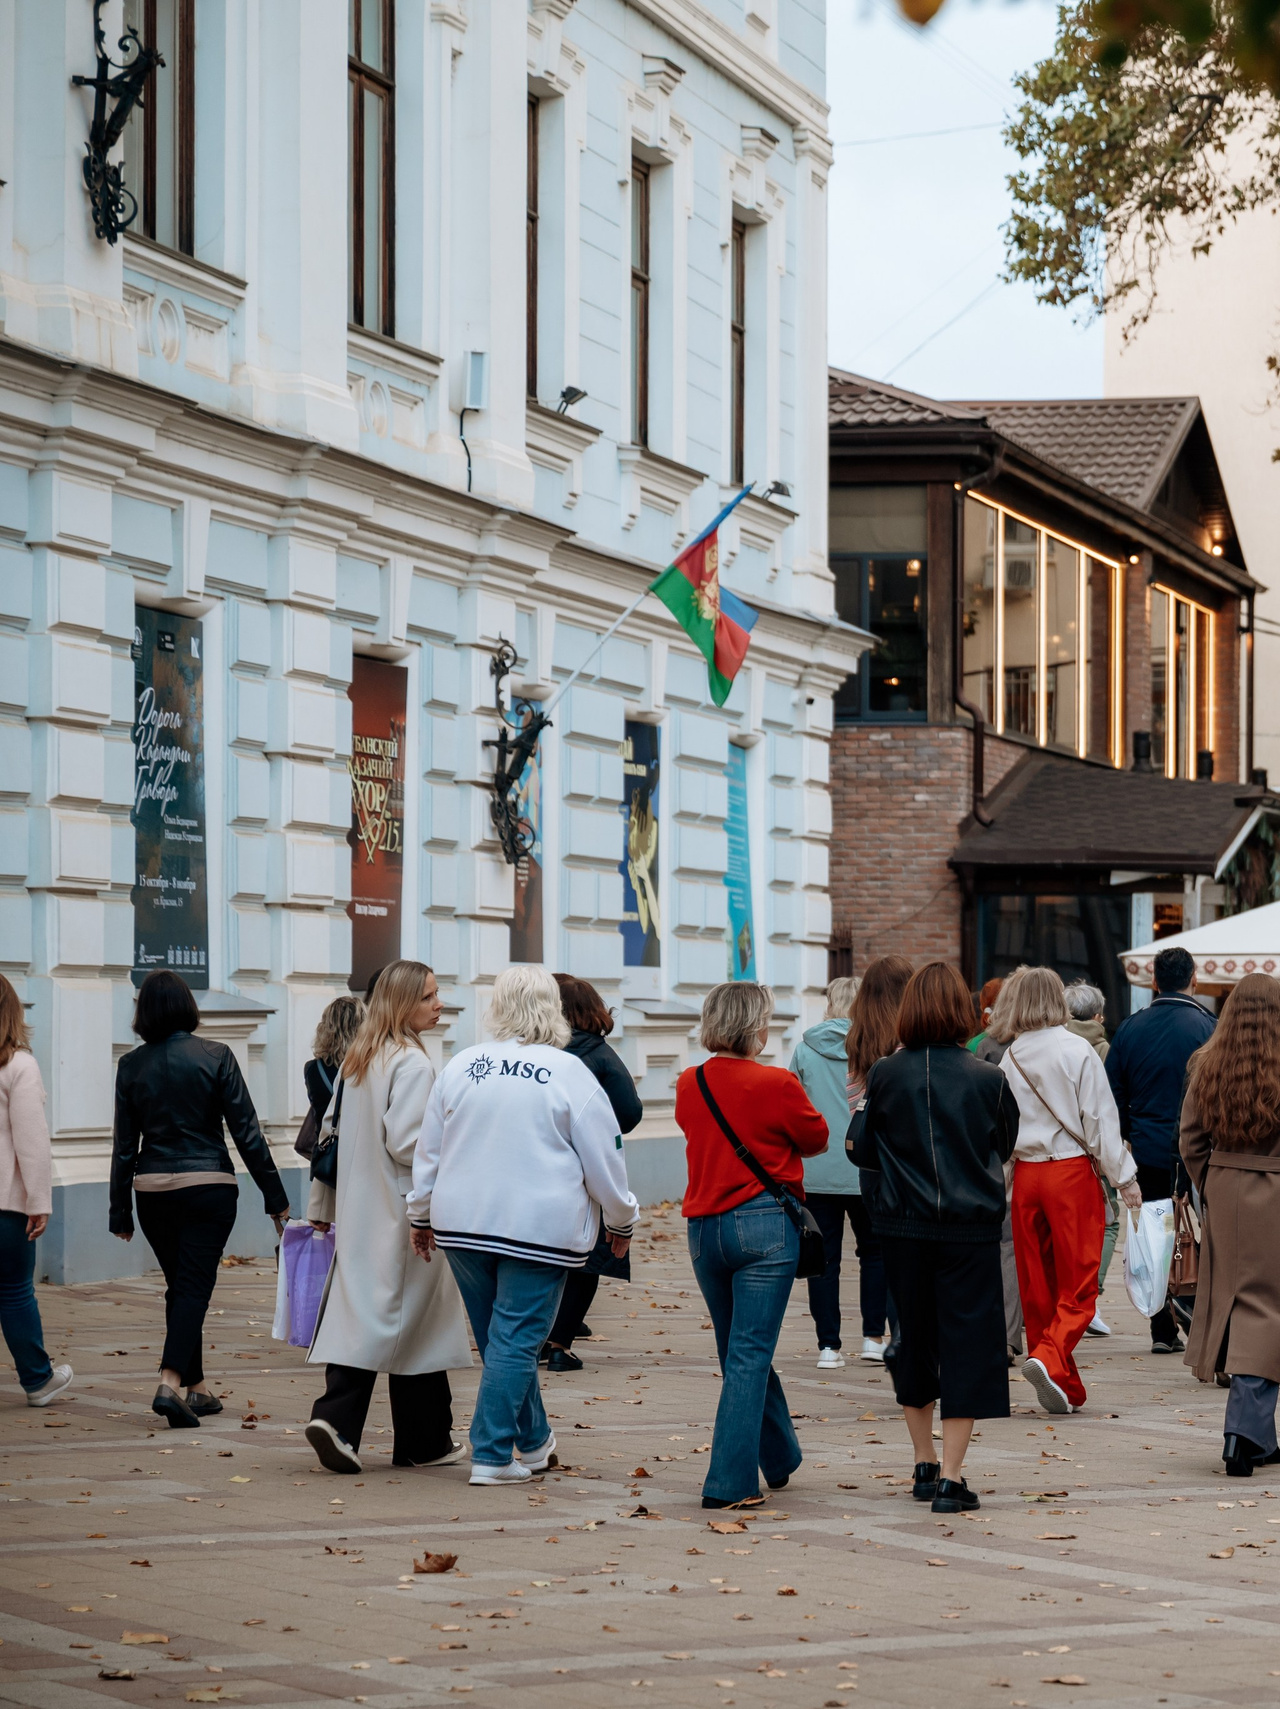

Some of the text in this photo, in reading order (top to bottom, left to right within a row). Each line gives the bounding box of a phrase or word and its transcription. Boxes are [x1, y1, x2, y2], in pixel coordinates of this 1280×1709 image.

[138, 687, 183, 745] Дорога
[135, 726, 191, 784] Карандаш
[134, 766, 179, 817] Гравюра
[354, 779, 386, 813] ХОР
[499, 1060, 552, 1085] MSC
